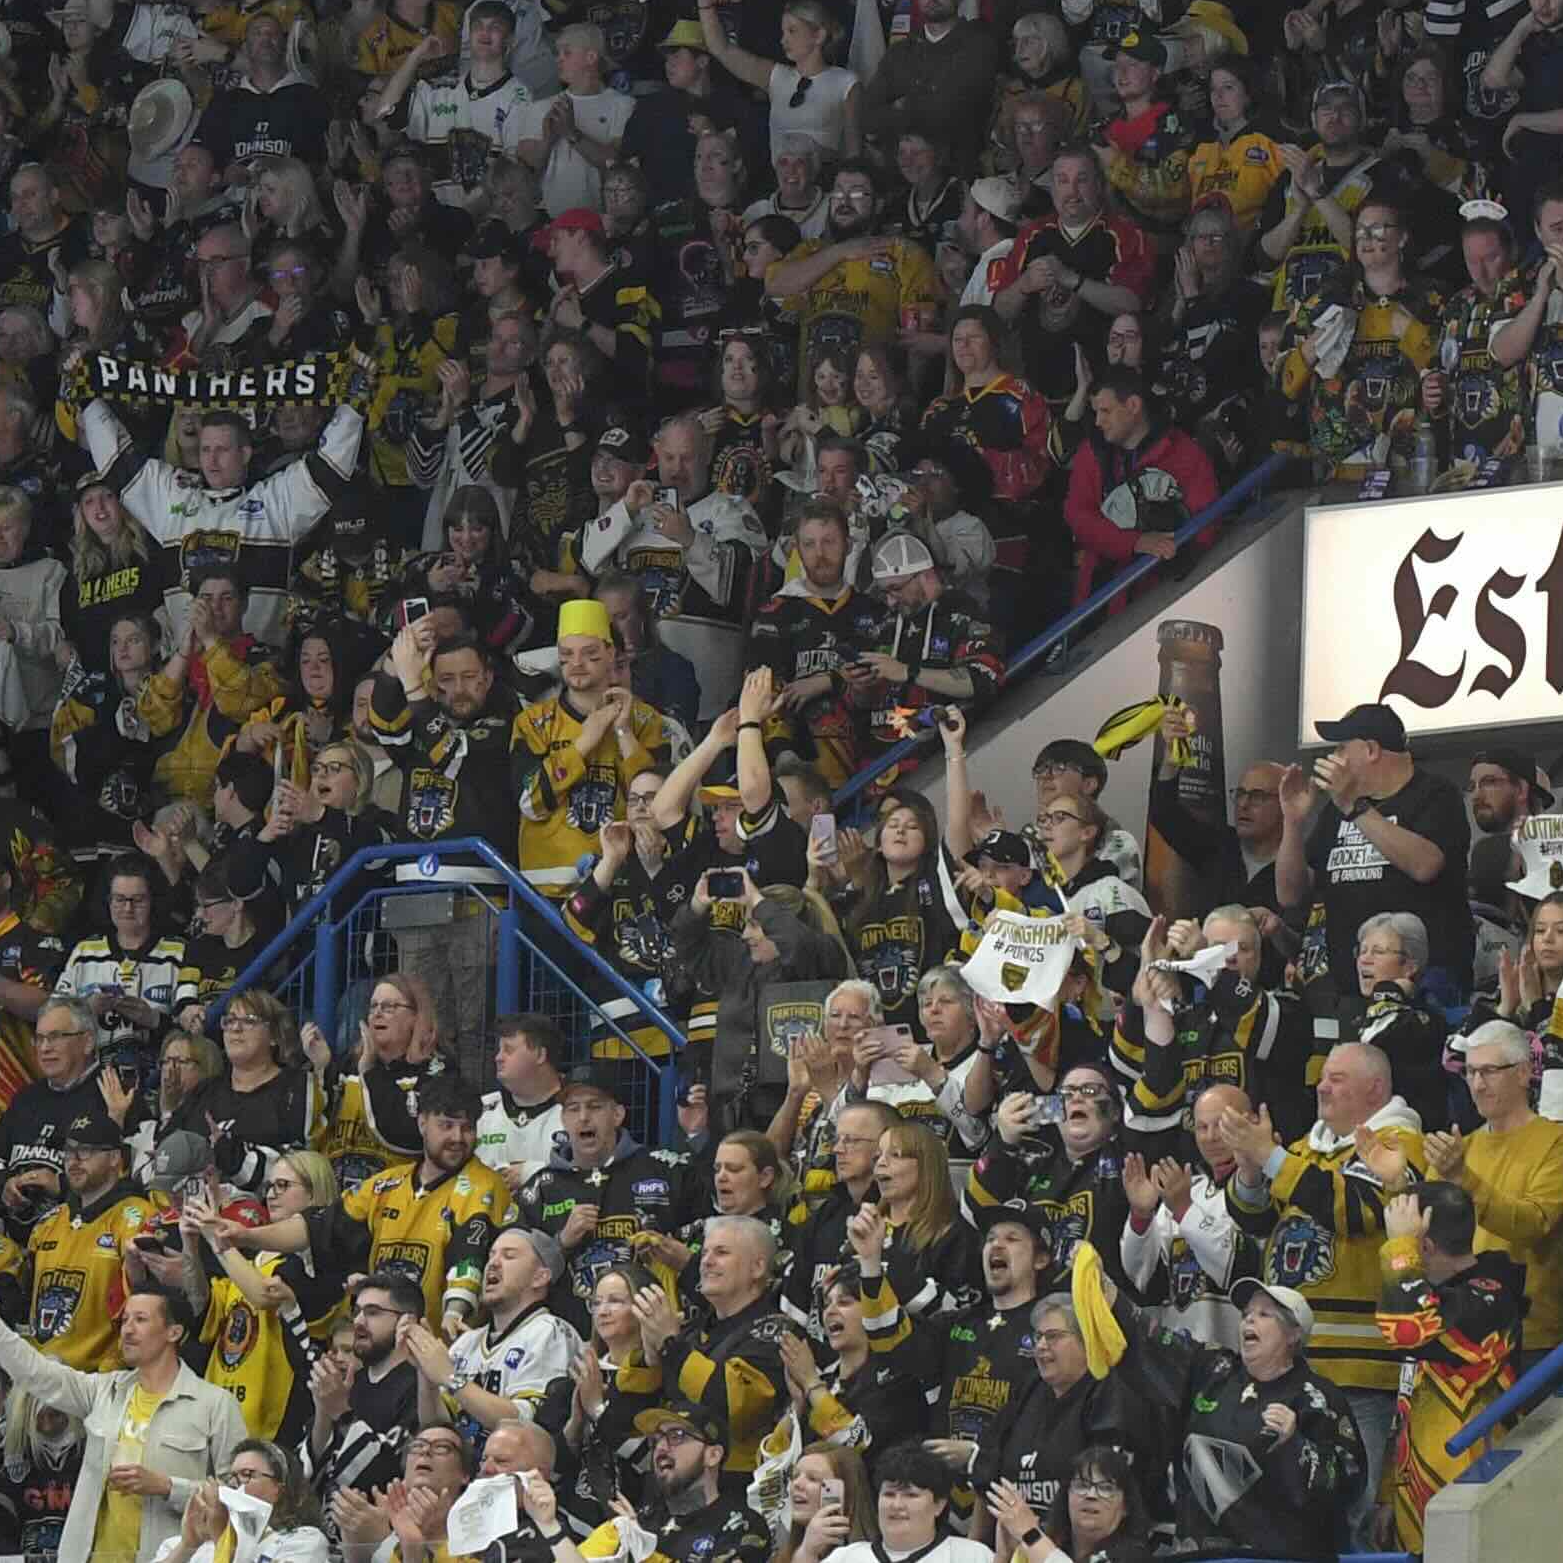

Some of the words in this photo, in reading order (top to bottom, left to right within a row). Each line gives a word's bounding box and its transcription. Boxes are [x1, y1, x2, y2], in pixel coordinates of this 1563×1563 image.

[96, 354, 317, 398] PANTHERS
[333, 517, 366, 532] WILD
[860, 920, 920, 951] ANTHERS
[21, 1484, 71, 1511] GM
